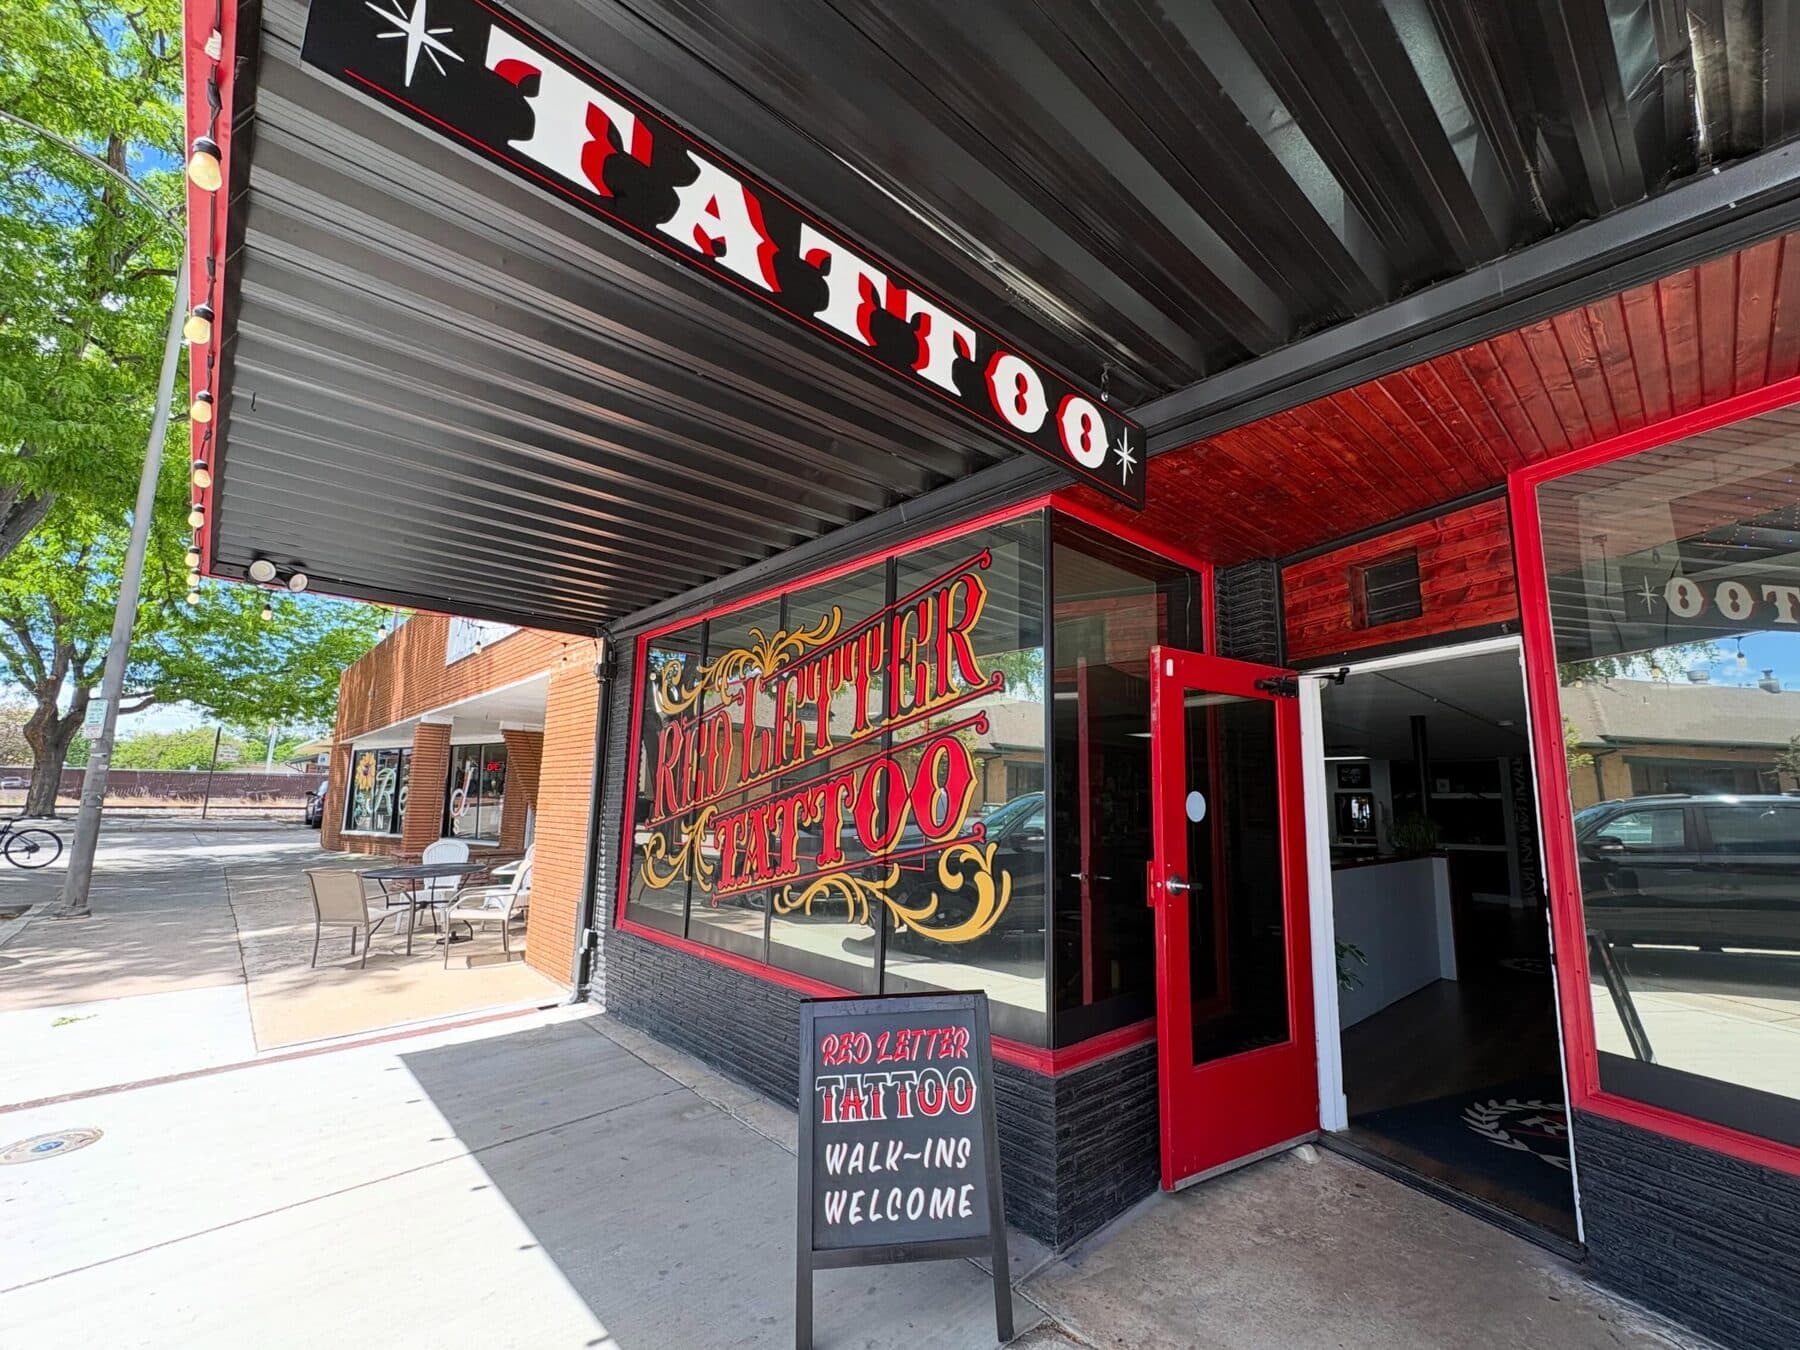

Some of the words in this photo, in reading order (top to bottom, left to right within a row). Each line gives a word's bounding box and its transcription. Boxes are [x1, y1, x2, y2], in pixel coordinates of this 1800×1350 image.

[484, 24, 1110, 469] TATTOO
[652, 709, 733, 821] RED
[736, 572, 988, 788] LETTER
[713, 736, 978, 891] TATTOO
[820, 1031, 873, 1066] RED
[876, 1026, 970, 1064] LETTER
[815, 1066, 977, 1123] TATTOO
[825, 1137, 972, 1176] WALK-INS
[824, 1184, 975, 1225] WELCOME
